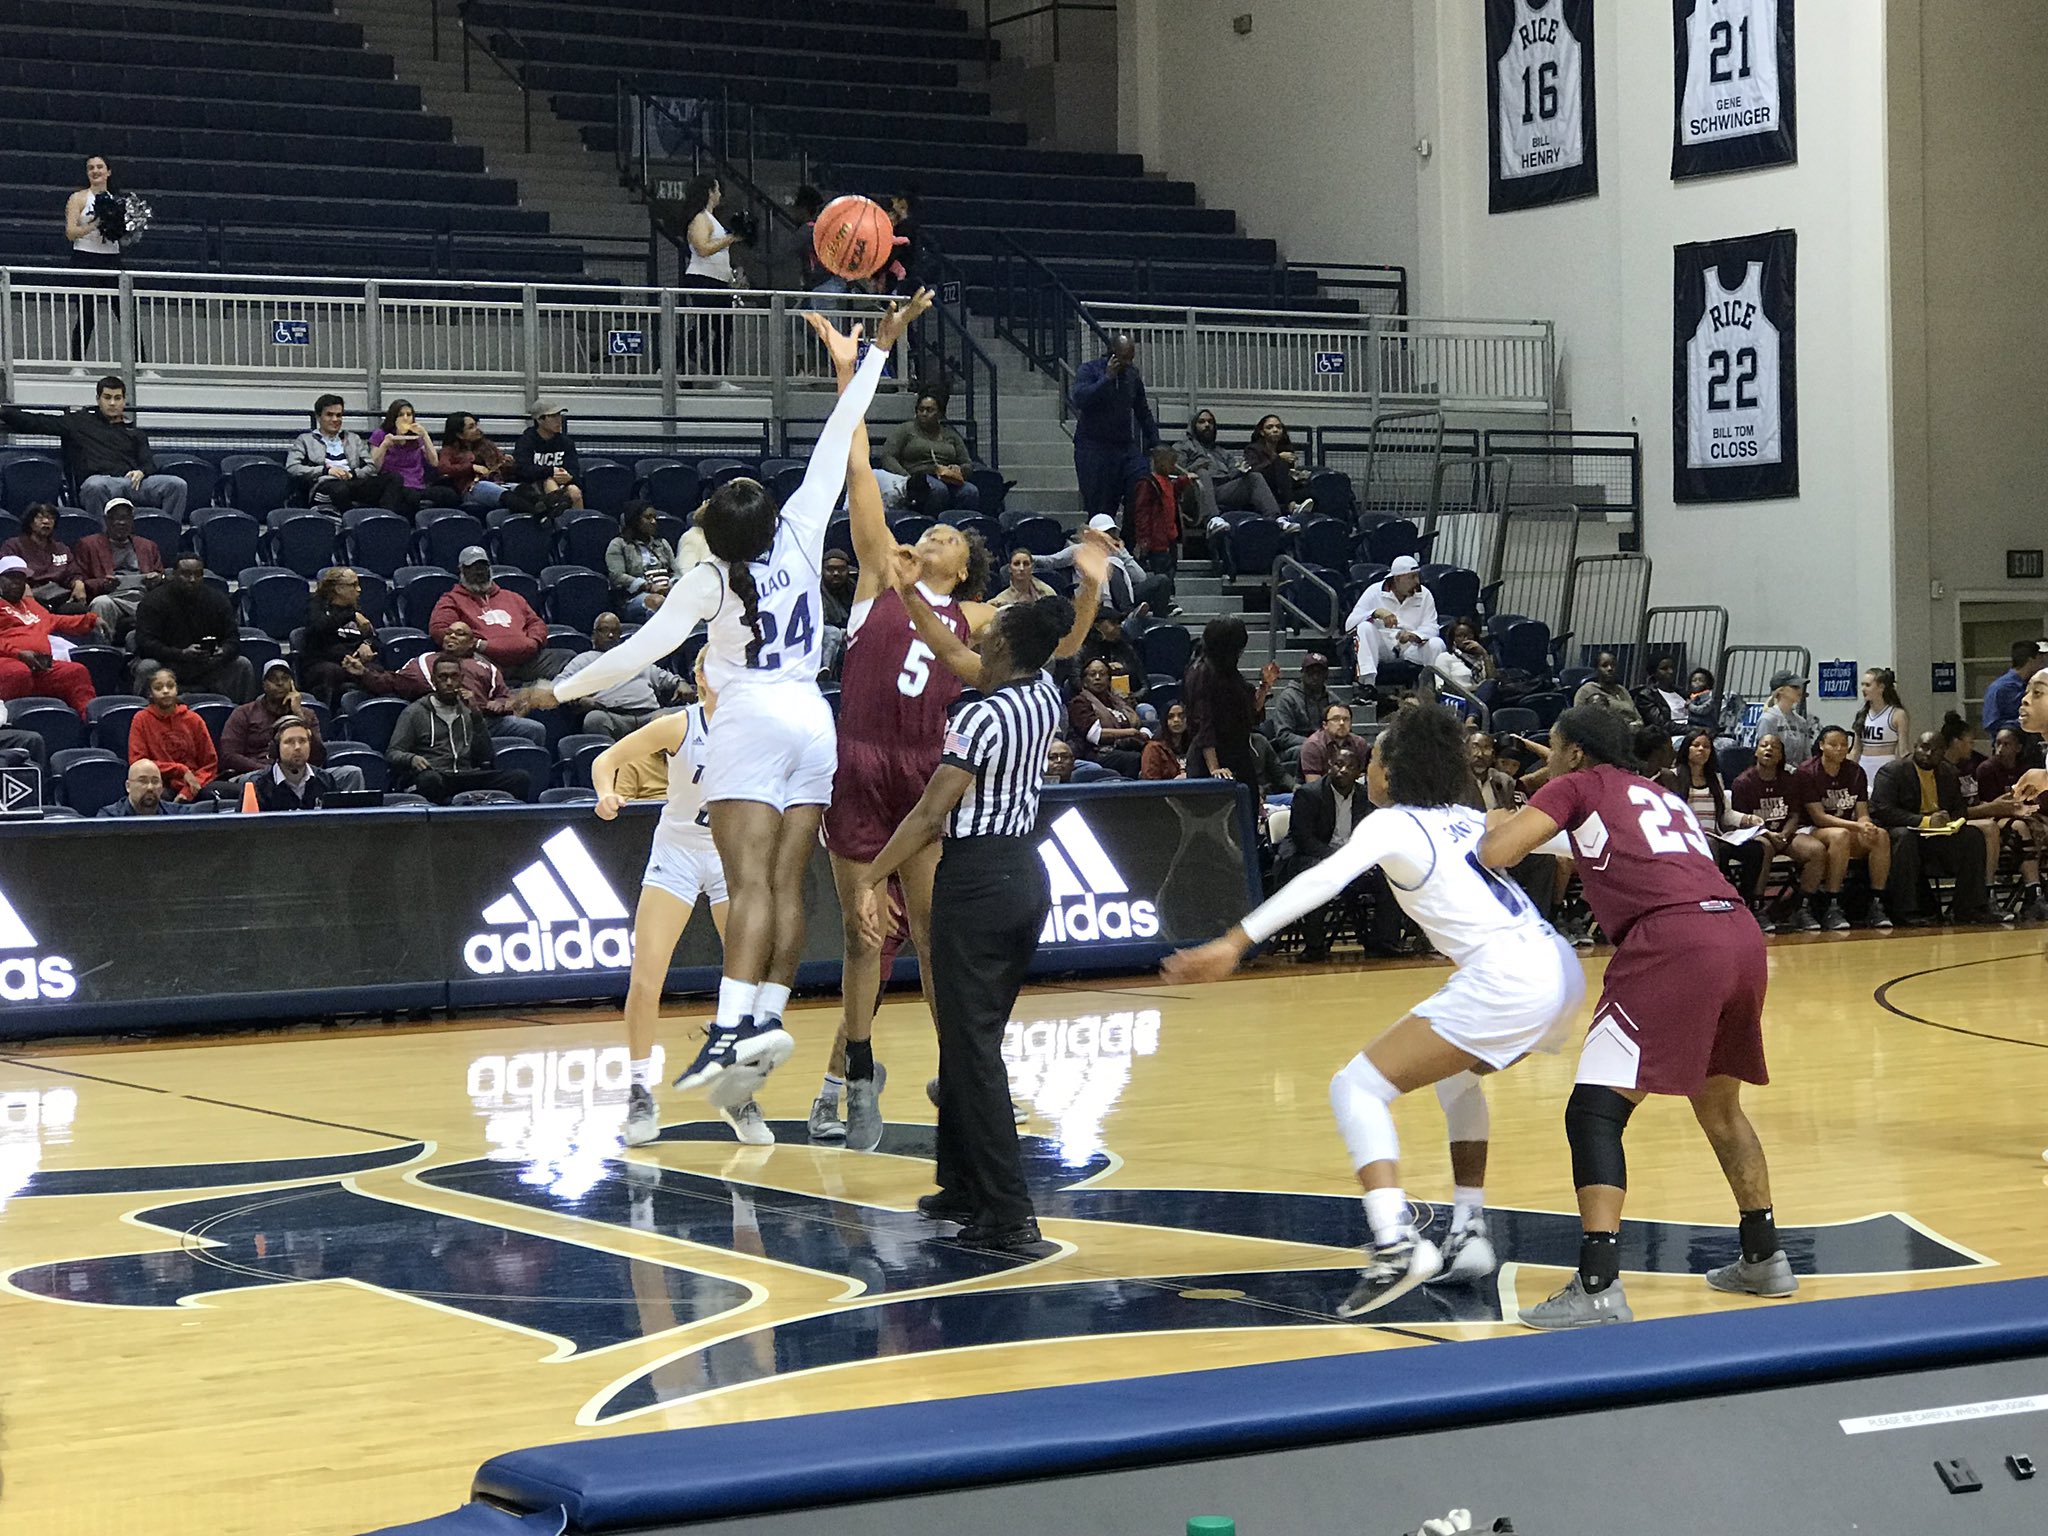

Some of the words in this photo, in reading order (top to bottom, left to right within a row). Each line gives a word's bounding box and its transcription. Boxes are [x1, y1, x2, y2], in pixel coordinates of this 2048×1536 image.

[1519, 18, 1559, 50] RICE
[1710, 16, 1750, 83] 21
[1521, 62, 1559, 124] 16
[1716, 97, 1742, 111] GENE
[1691, 107, 1770, 135] SCHWINGER
[1532, 136, 1550, 148] BILL
[1521, 148, 1560, 169] HENRY
[657, 180, 686, 200] EXIT
[1710, 300, 1756, 332] RICE
[1708, 347, 1758, 411] 22
[1713, 427, 1733, 439] BILL
[1734, 425, 1754, 438] TOM
[1711, 440, 1757, 459] CLOSS
[760, 569, 791, 598] LAO
[748, 592, 814, 670] 24
[897, 639, 936, 698] 5
[1824, 680, 1850, 693] 113/117
[1860, 726, 1883, 740] WLS
[1627, 785, 1714, 861] 23
[1038, 892, 1160, 944] idas
[463, 917, 637, 975] adida
[1914, 1409, 1953, 1422] CAREFUL
[1955, 1406, 1980, 1417] WHEN
